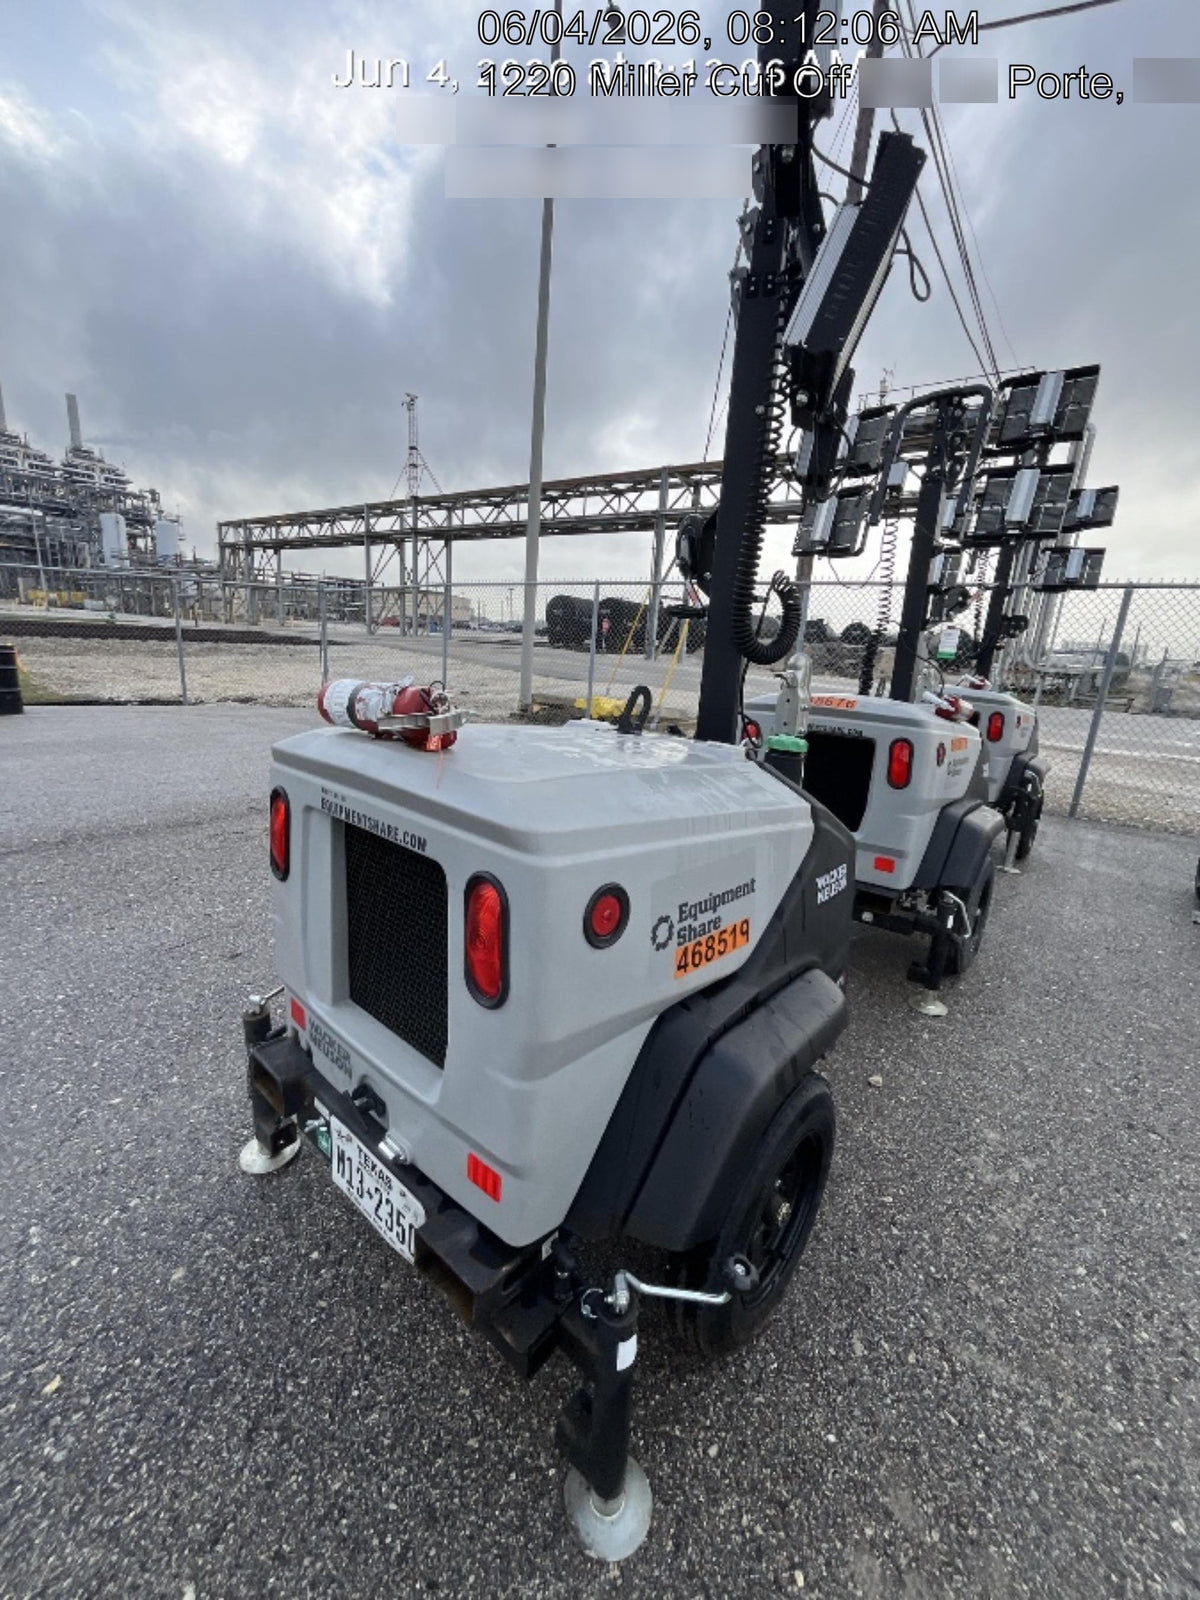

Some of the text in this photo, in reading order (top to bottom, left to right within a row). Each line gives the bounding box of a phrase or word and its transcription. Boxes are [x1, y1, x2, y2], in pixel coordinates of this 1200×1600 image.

[678, 878, 756, 923] Equipment
[676, 918, 750, 973] 468519
[677, 916, 722, 946] Share
[357, 1144, 393, 1189] TEXAS
